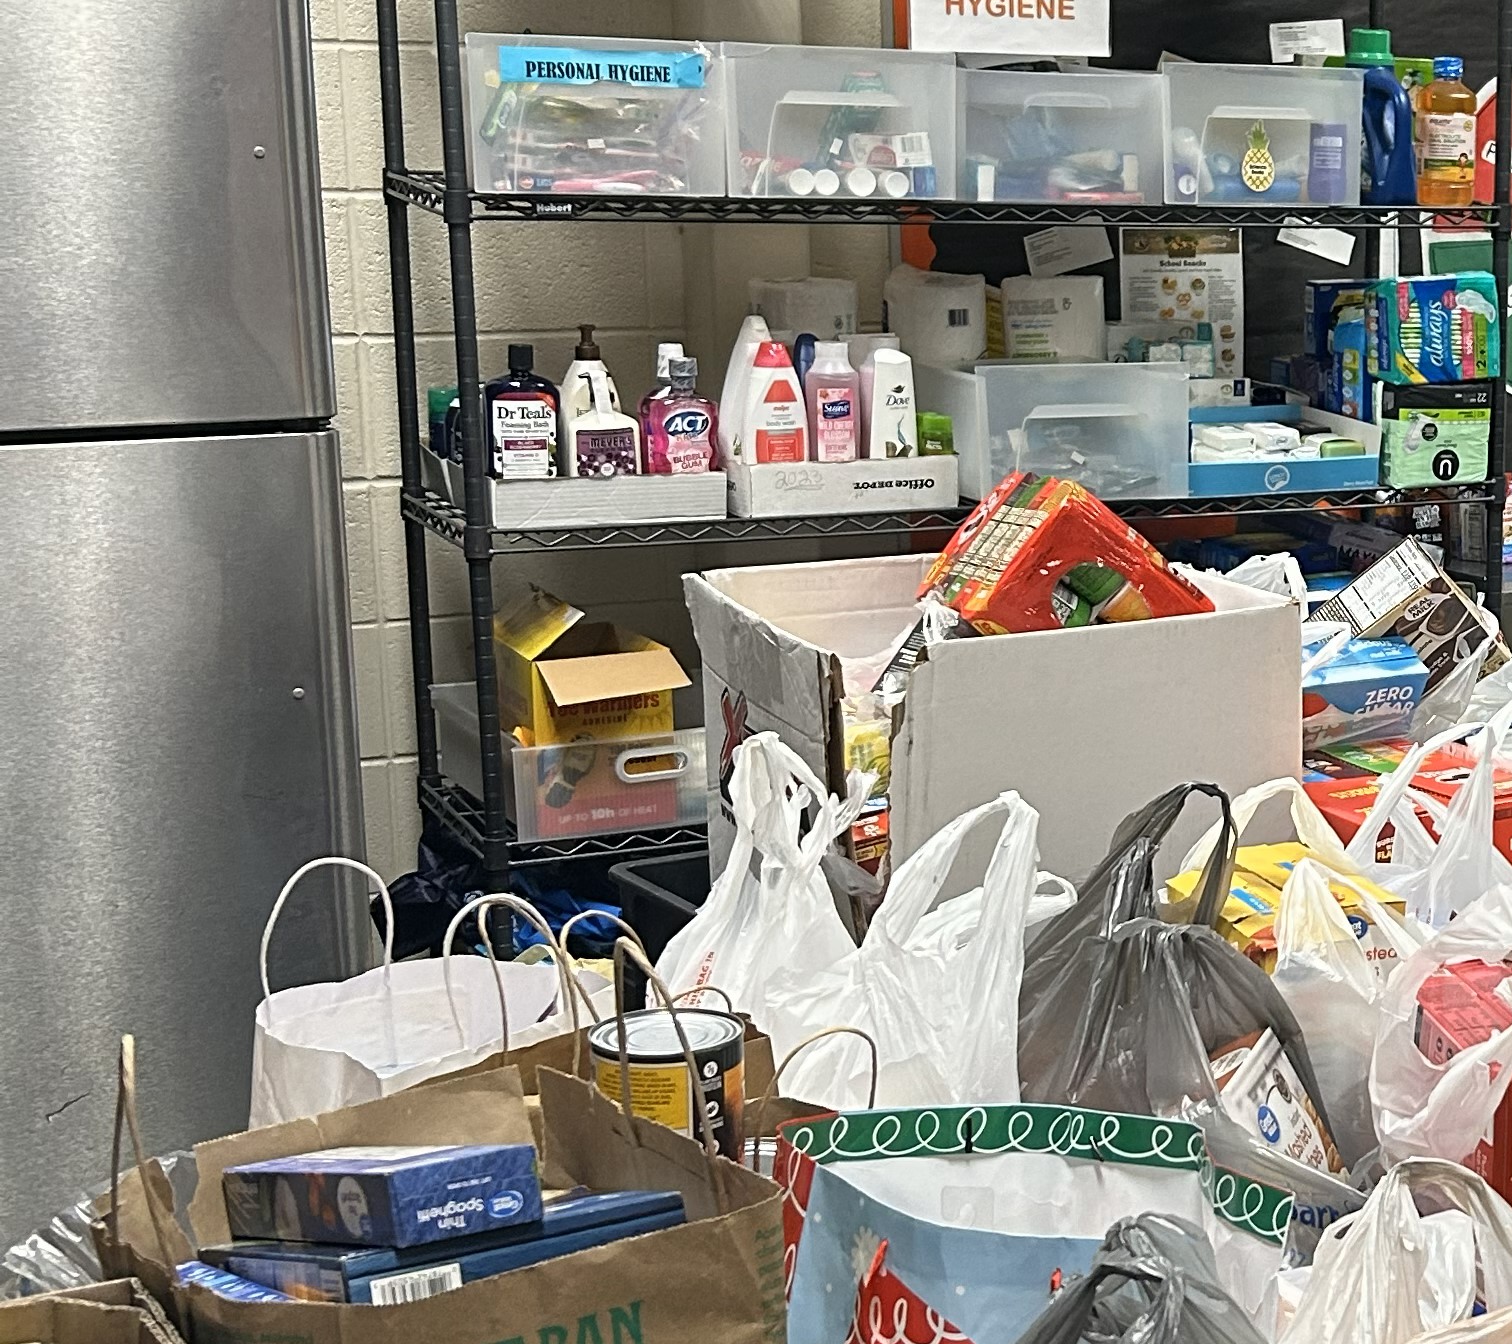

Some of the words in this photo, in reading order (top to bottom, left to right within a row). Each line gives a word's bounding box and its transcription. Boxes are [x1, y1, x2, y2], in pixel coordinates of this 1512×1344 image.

[525, 60, 601, 80] PERSONAL
[608, 64, 671, 83] HYGIENE
[537, 203, 572, 212] Hubert
[1425, 299, 1449, 367] always
[824, 403, 849, 414] Suave
[886, 394, 910, 406] Dove
[497, 407, 516, 419] Dr
[517, 406, 552, 419] Teal's
[668, 416, 707, 433] ACT
[895, 478, 935, 490] Office
[1407, 596, 1430, 614] REAL
[1411, 601, 1435, 619] MILK
[1365, 686, 1413, 706] ZERO
[417, 1197, 486, 1223] Spaghetti
[437, 1213, 466, 1230] Thin
